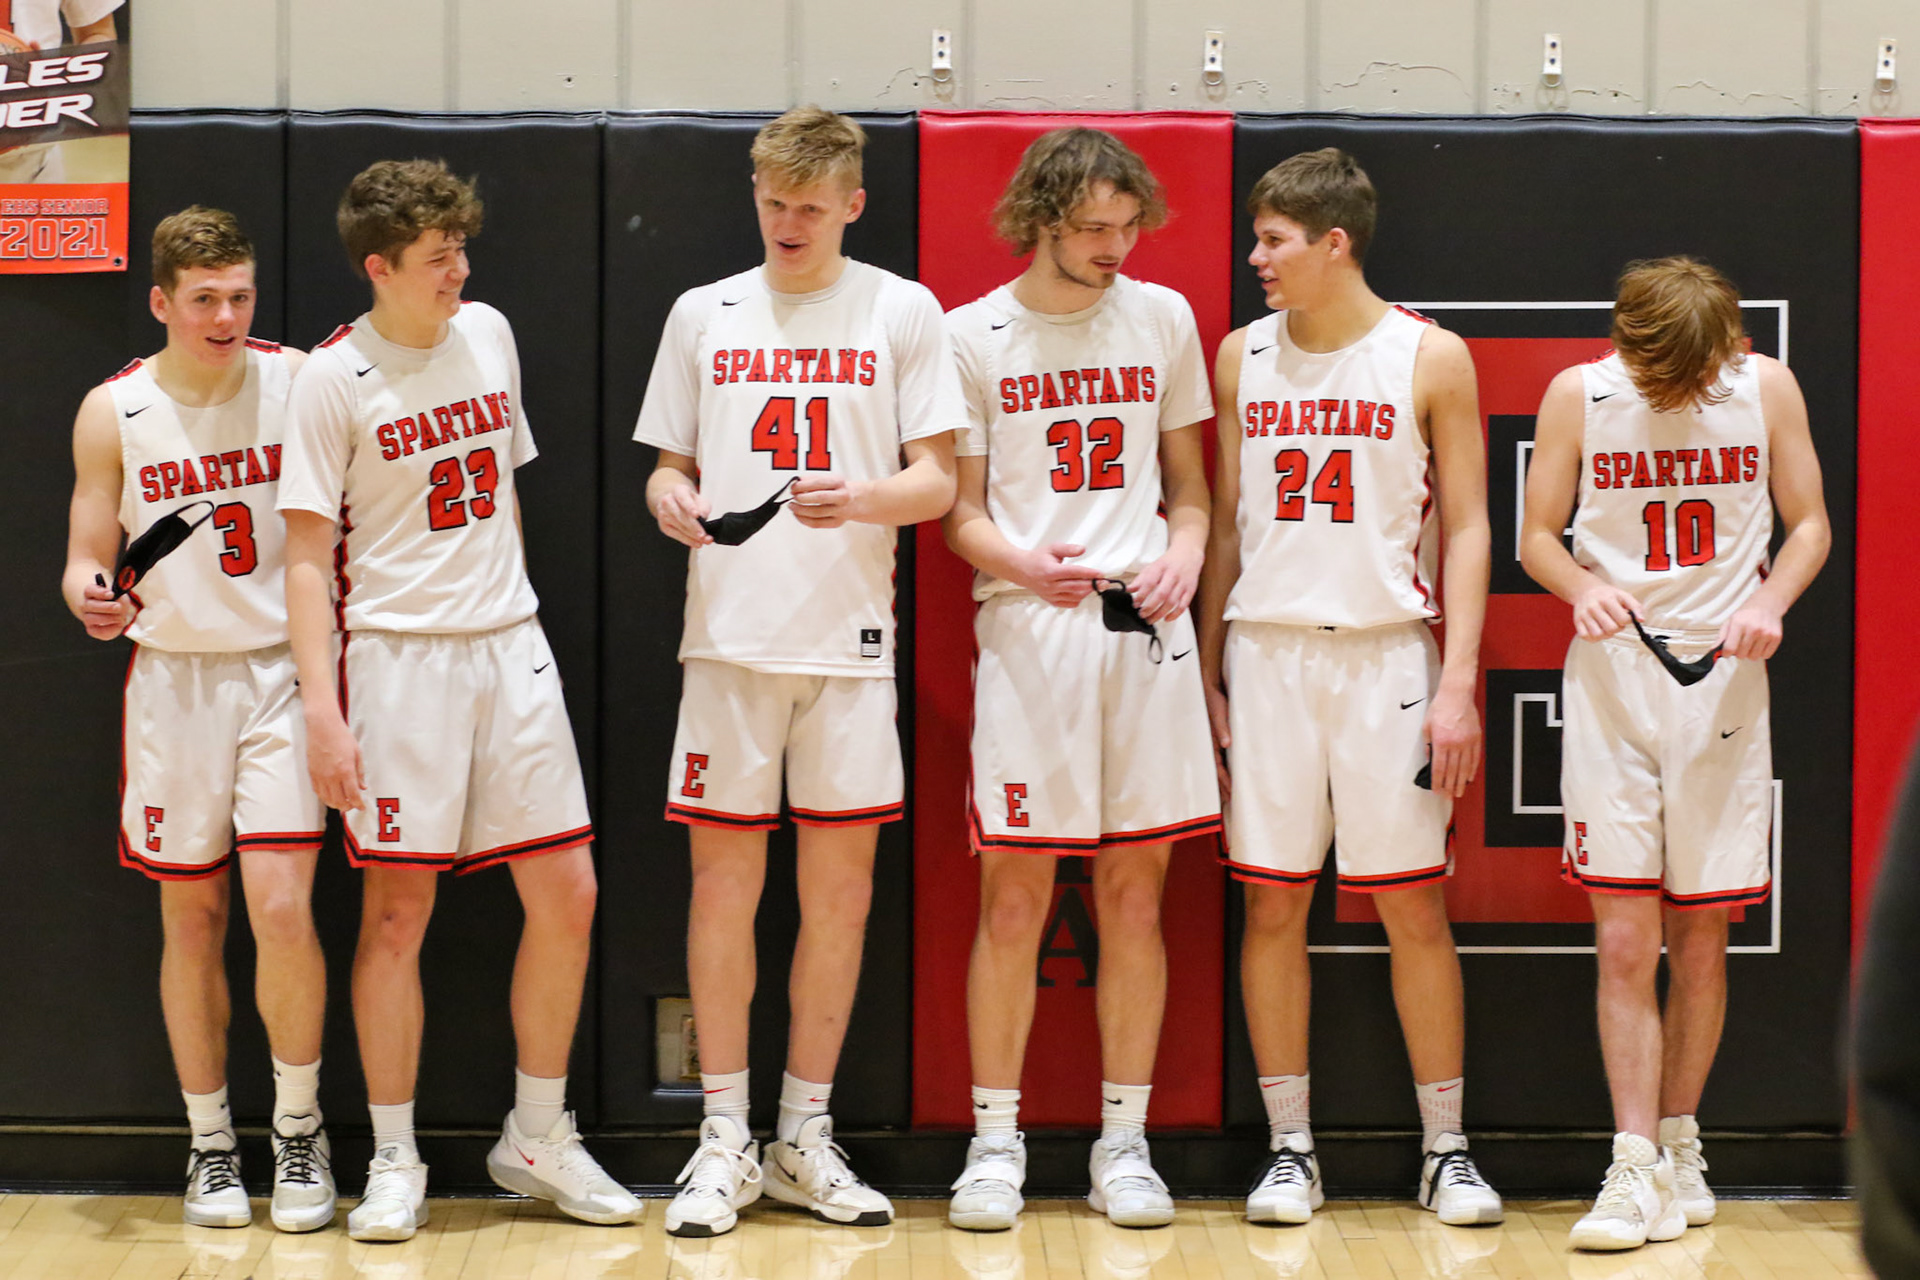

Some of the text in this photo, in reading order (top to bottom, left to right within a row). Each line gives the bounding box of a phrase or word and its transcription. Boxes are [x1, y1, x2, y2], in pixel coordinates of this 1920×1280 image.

[0, 93, 99, 129] ER
[1, 198, 109, 215] EHS SENIOR
[0, 218, 109, 259] 2021
[713, 348, 877, 386] SPARTANS
[1000, 366, 1156, 414] SPARTANS
[377, 391, 511, 461] SPARTANS
[751, 396, 831, 471] 41
[1246, 399, 1396, 440] SPARTANS
[1046, 416, 1124, 493] 32
[1593, 445, 1759, 489] SPARTANS
[428, 447, 499, 532] 23
[1275, 448, 1355, 524] 24
[213, 501, 258, 578] 3
[1643, 498, 1715, 571] 10
[682, 752, 709, 799] E
[144, 805, 164, 852] E
[376, 797, 400, 842] E
[1003, 783, 1030, 828] E
[1573, 821, 1589, 866] E
